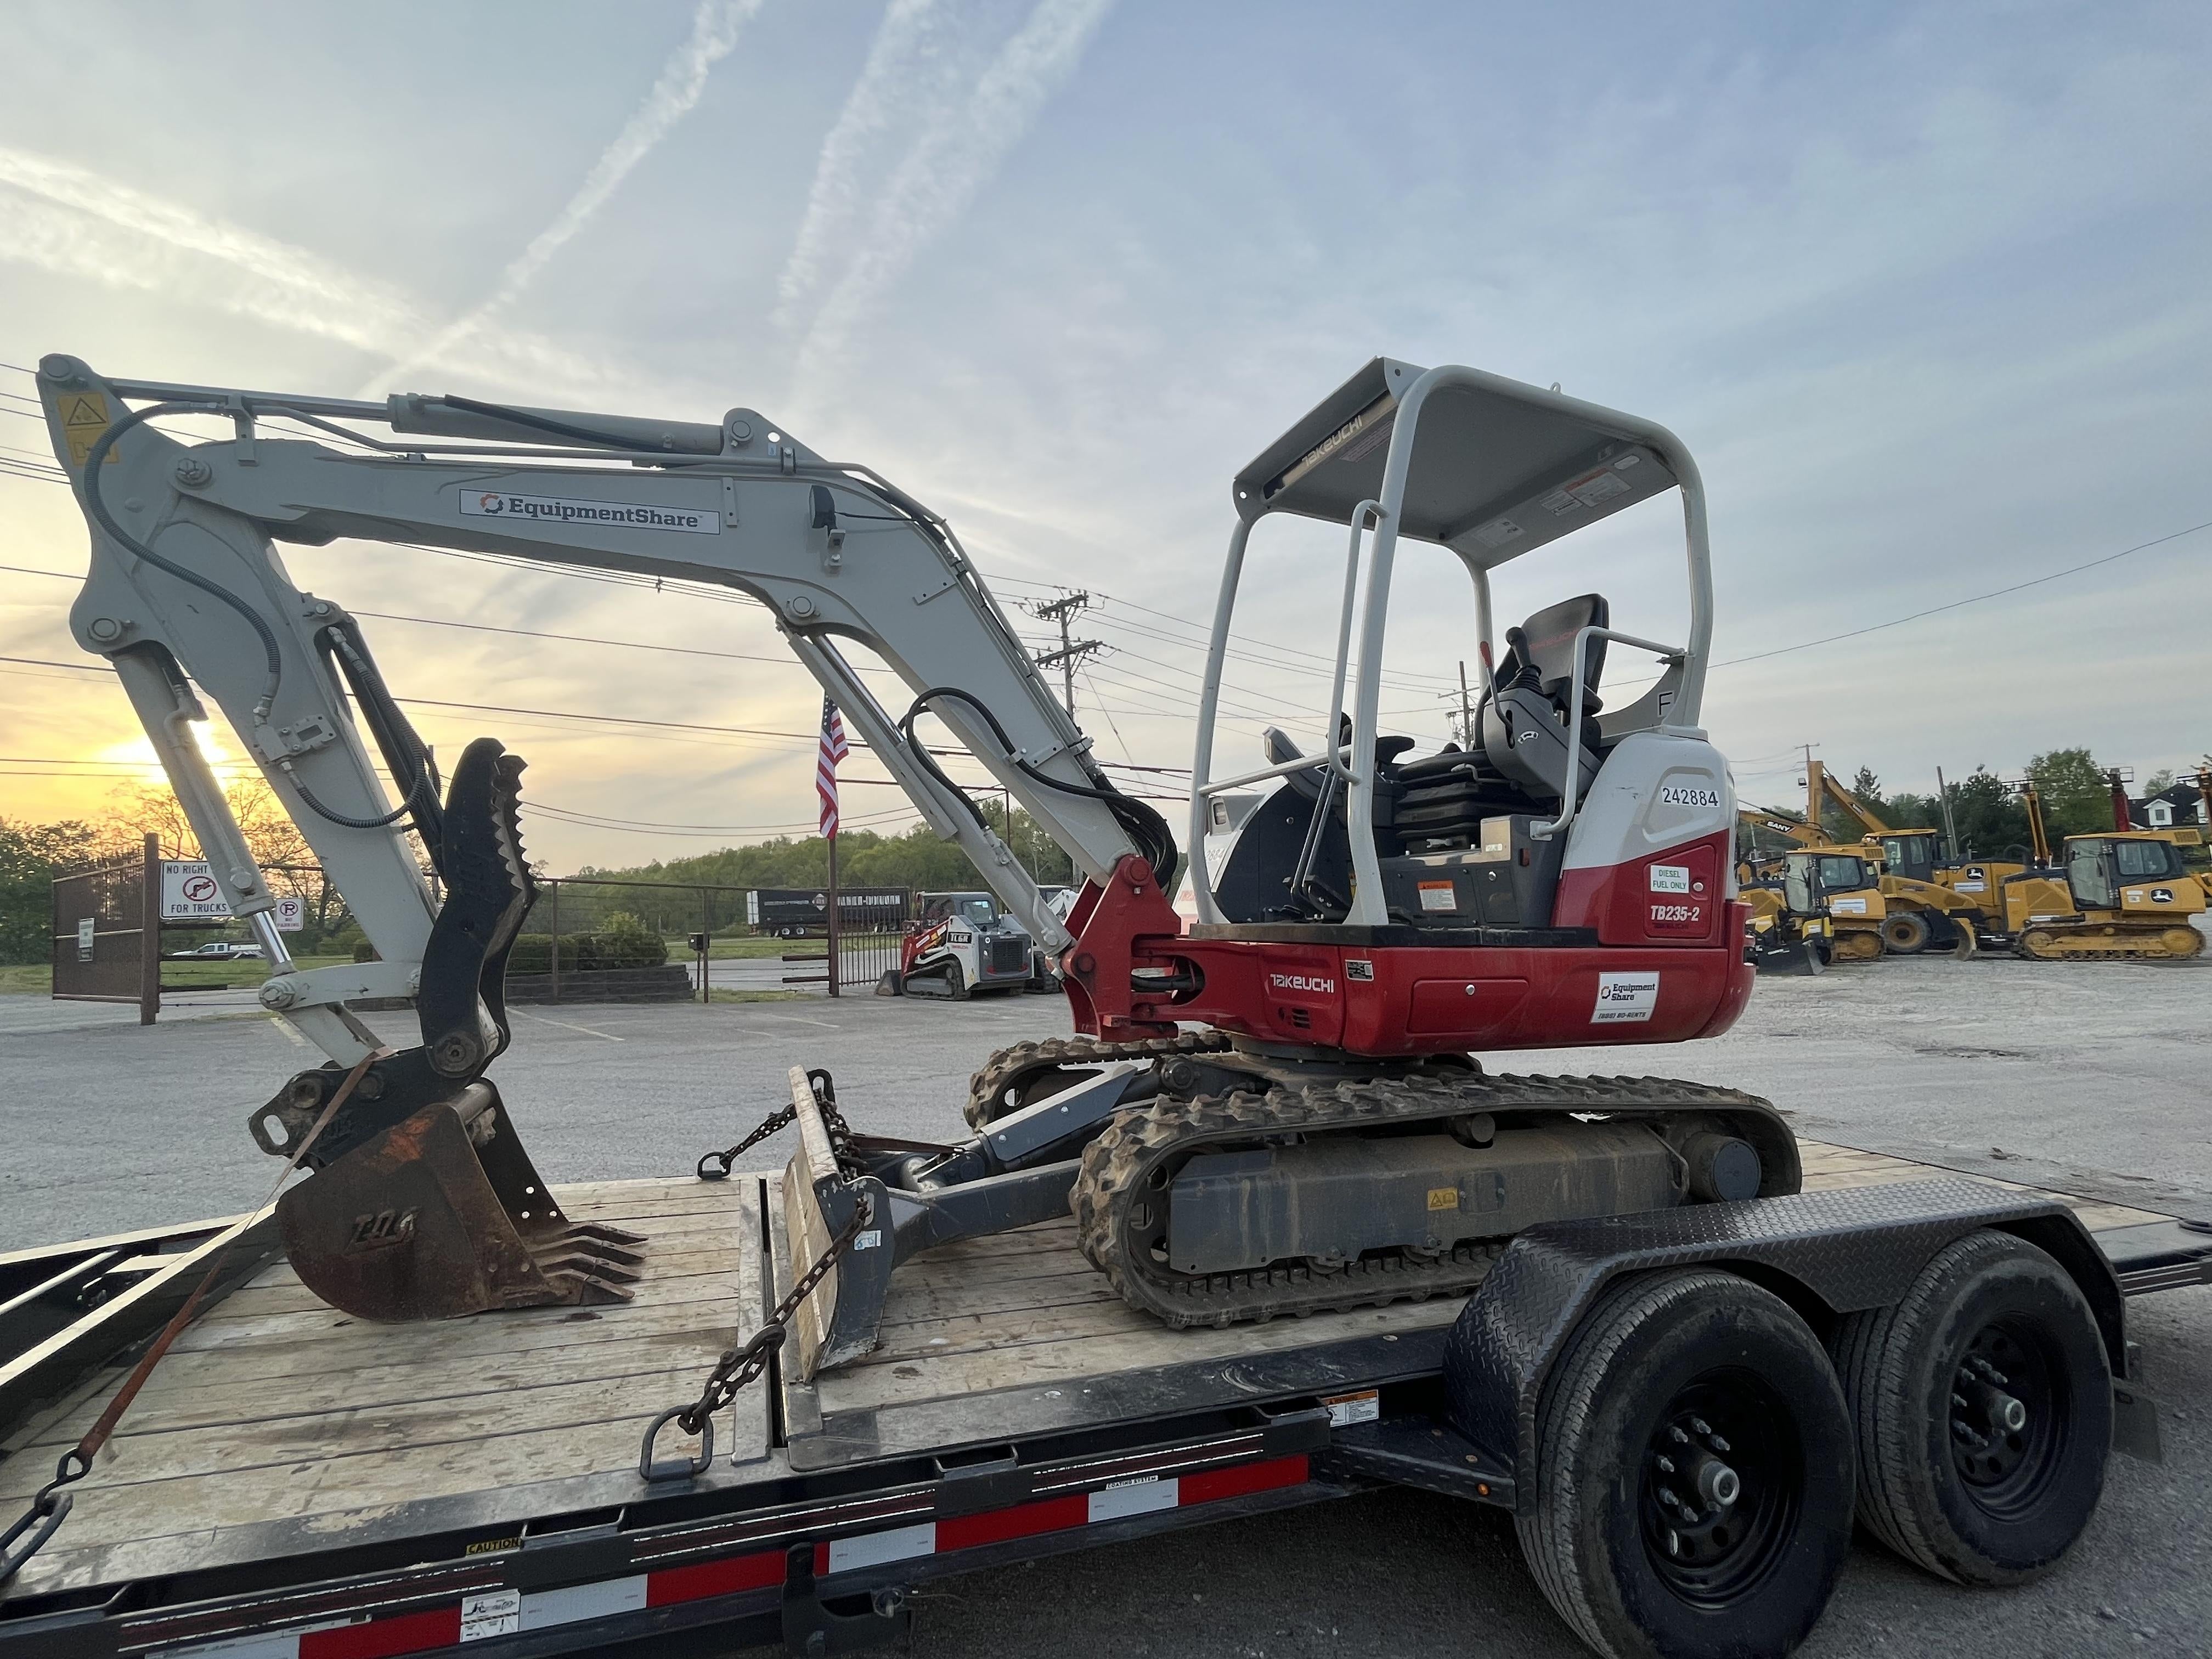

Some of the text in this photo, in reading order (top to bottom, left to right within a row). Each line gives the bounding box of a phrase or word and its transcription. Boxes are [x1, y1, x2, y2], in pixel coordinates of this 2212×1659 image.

[509, 497, 698, 528] EquipmentShare
[1658, 692, 1673, 715] F
[1662, 787, 1719, 806] 242884
[1767, 821, 1791, 832] SANY
[166, 865, 208, 874] NO RIGHT
[1658, 869, 1681, 878] DIESEL
[1652, 880, 1687, 889] FUEL ONLY
[171, 903, 227, 913] FOR TRUCKS
[1650, 905, 1700, 922] TB235-2
[1612, 983, 1656, 993] Equipment
[469, 1537, 519, 1554] CAUTION
